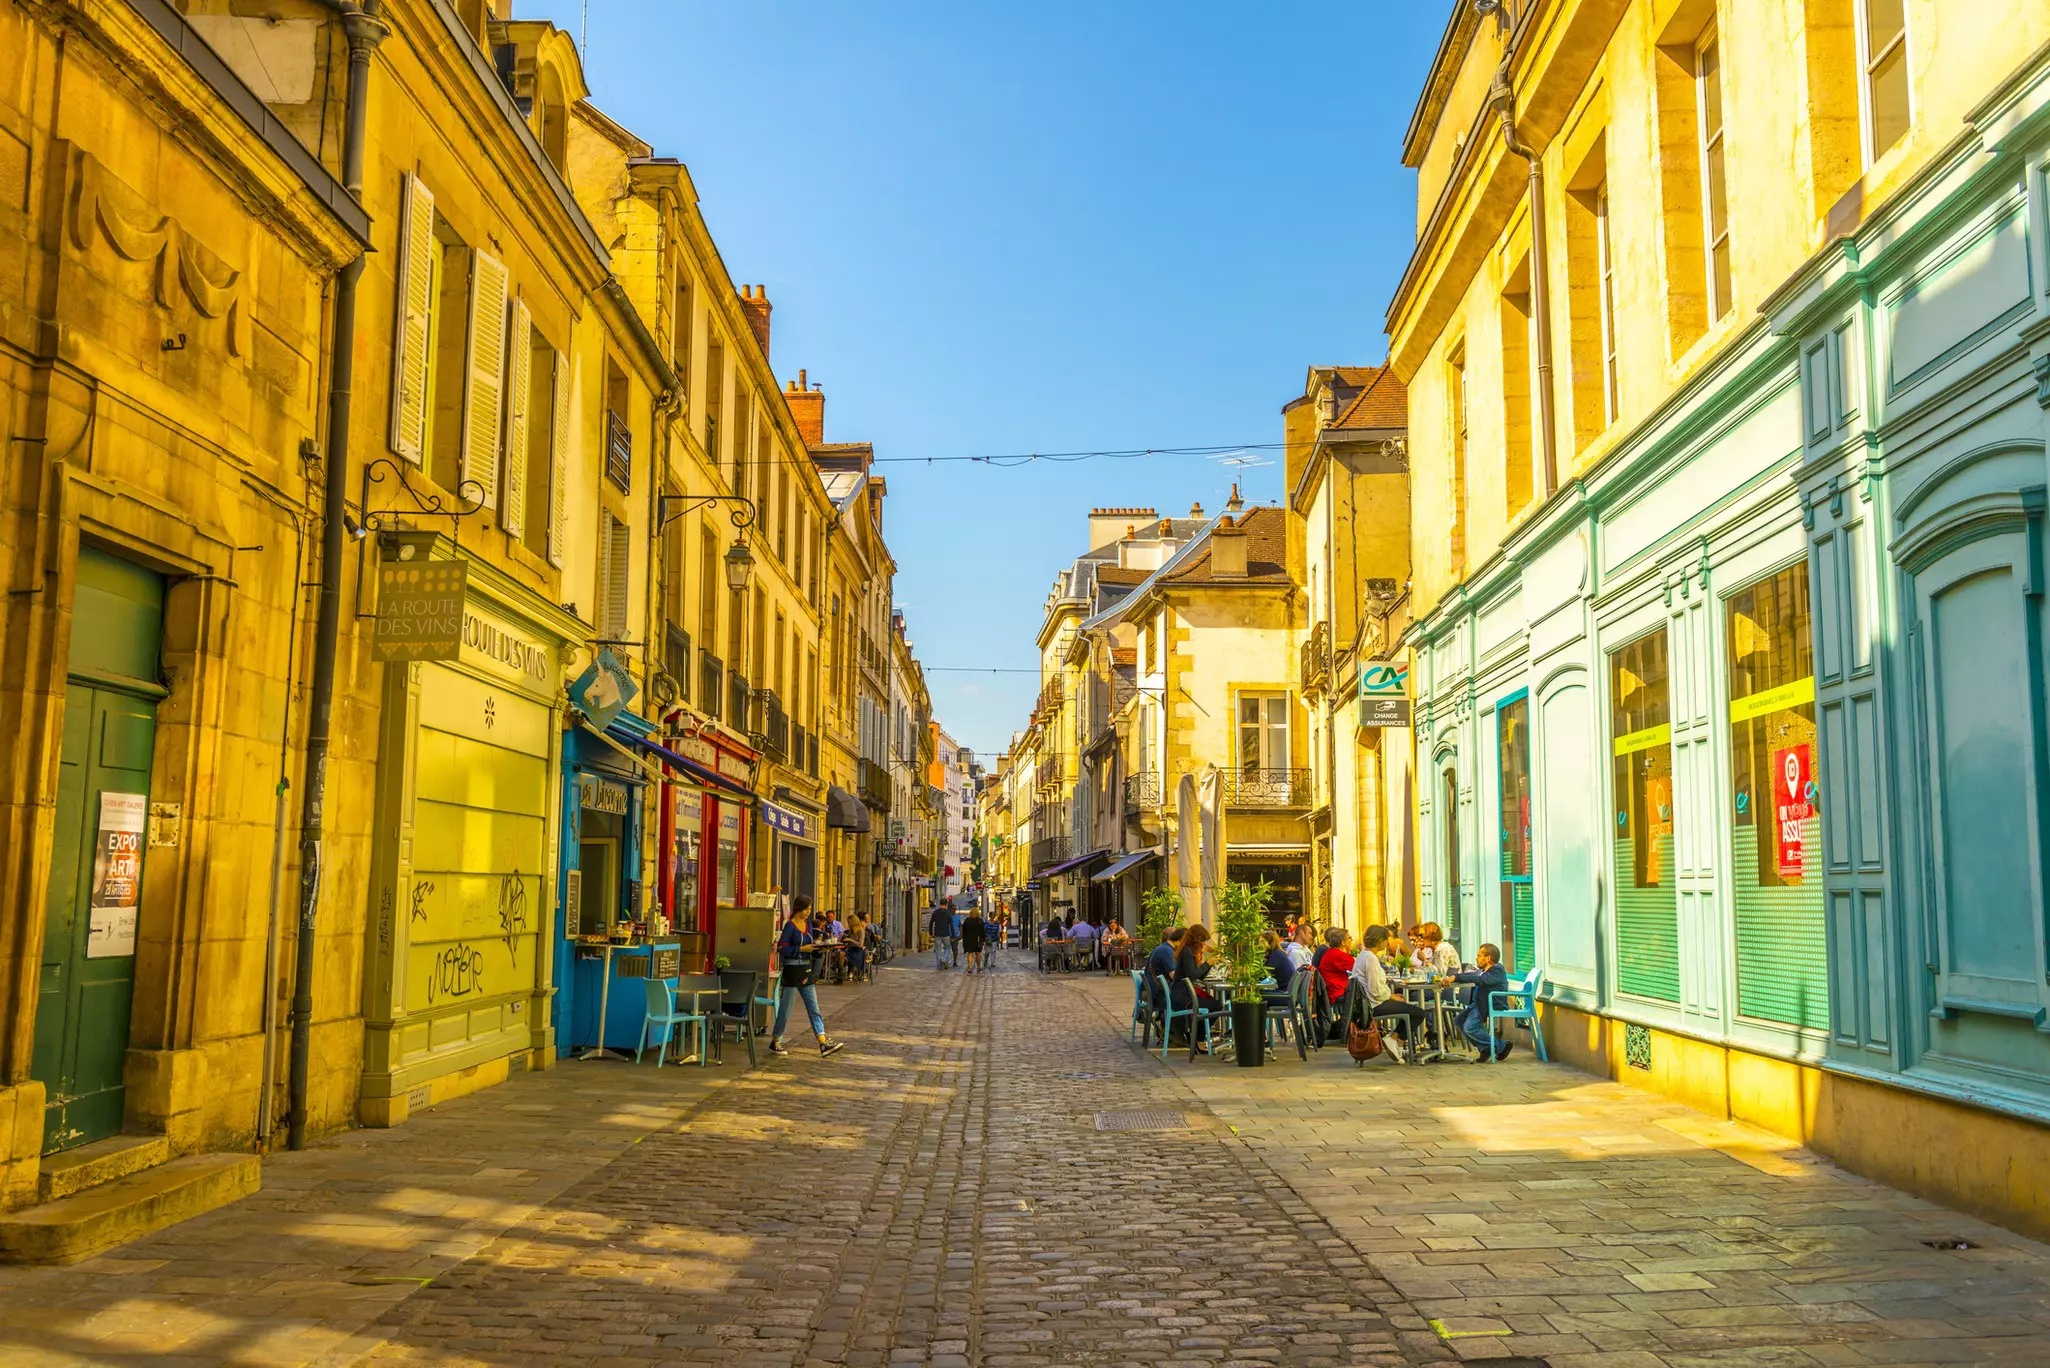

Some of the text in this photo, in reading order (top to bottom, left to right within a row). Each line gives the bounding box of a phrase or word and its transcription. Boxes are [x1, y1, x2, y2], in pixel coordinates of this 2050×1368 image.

[379, 598, 459, 616] LA ROUTE
[378, 617, 459, 636] DES VINS
[502, 636, 523, 670] DES
[523, 644, 548, 681] VINS
[1364, 664, 1408, 690] CA
[108, 833, 137, 851] EXPO
